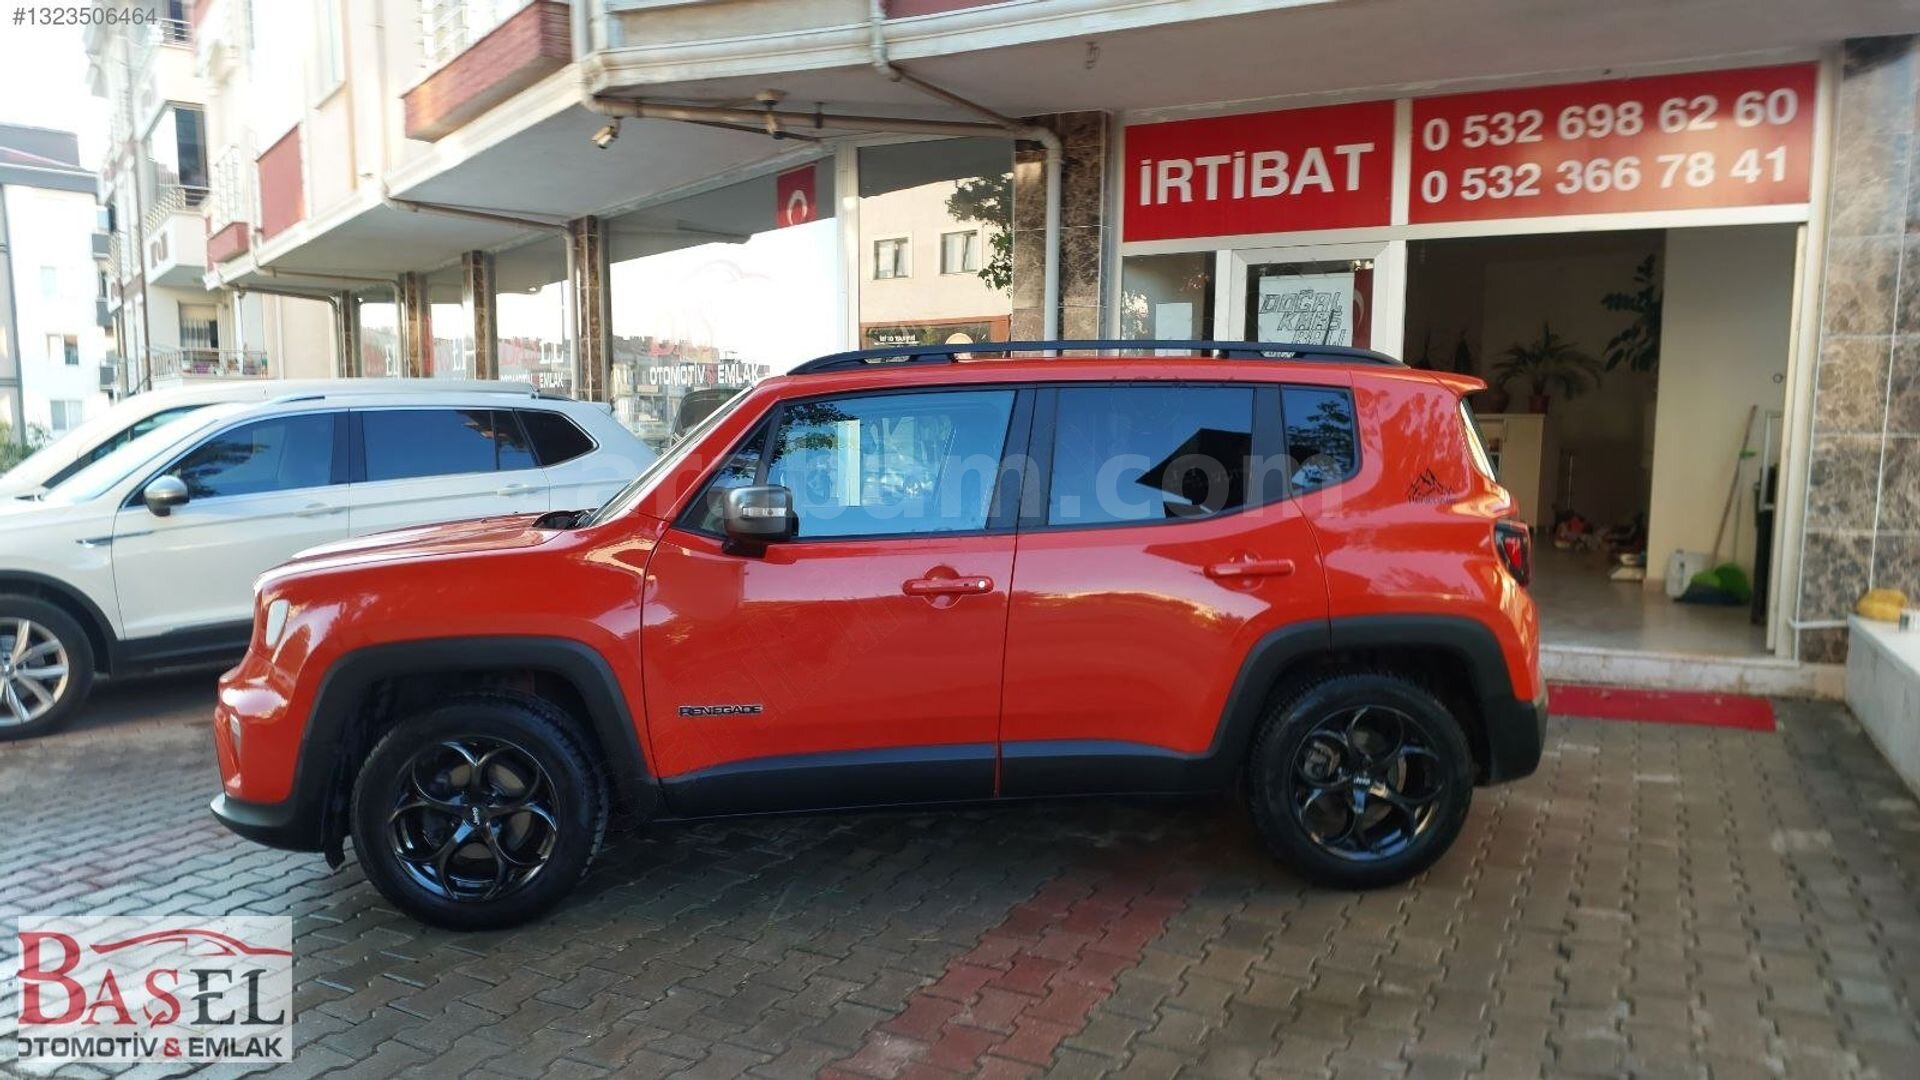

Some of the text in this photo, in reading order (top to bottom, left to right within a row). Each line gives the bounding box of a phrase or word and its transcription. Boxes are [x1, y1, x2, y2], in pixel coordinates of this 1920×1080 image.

[1423, 88, 1798, 151] 0 532 698 62 60
[1139, 142, 1376, 207] İRTİBAT
[1421, 145, 1787, 203] 0 532 366 78 41
[717, 362, 760, 385] EMLAK
[678, 704, 763, 717] RENEGADE
